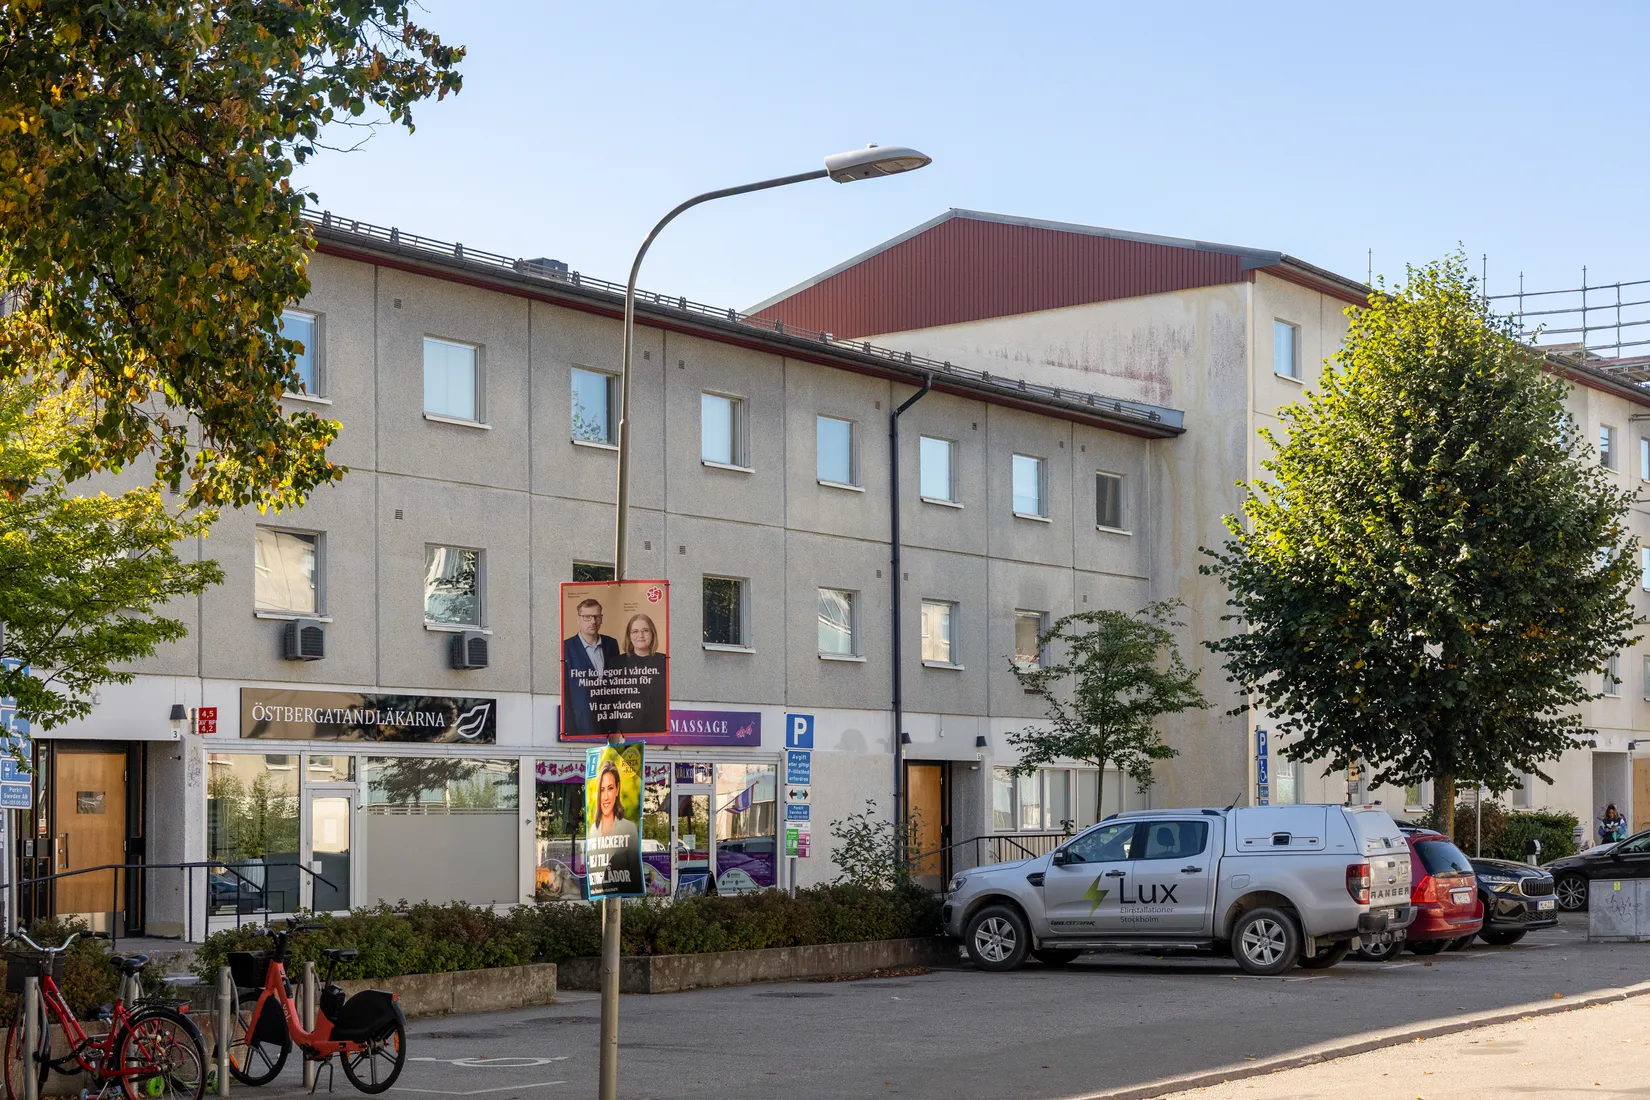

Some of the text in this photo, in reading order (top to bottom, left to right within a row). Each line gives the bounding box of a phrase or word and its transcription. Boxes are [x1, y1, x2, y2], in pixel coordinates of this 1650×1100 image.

[570, 668, 586, 678] Fler
[588, 667, 622, 677] kolegor
[628, 666, 660, 676] vården.
[578, 676, 652, 687] Mindre väntan för
[590, 687, 640, 698] patienterna.
[589, 701, 642, 711] Vi tar vården
[202, 710, 214, 718] 4,5
[252, 702, 446, 728] ÖSTBERGATANDLÄKARNA
[597, 711, 634, 722] på allvar.
[670, 719, 728, 734] MASSAGE
[794, 717, 808, 746] P
[173, 730, 178, 738] 3
[1260, 733, 1266, 754] P
[598, 834, 630, 850] VACKERT
[1120, 878, 1178, 904] Lux
[1370, 887, 1409, 899] RANGER
[1120, 906, 1174, 914] Elinstallationer
